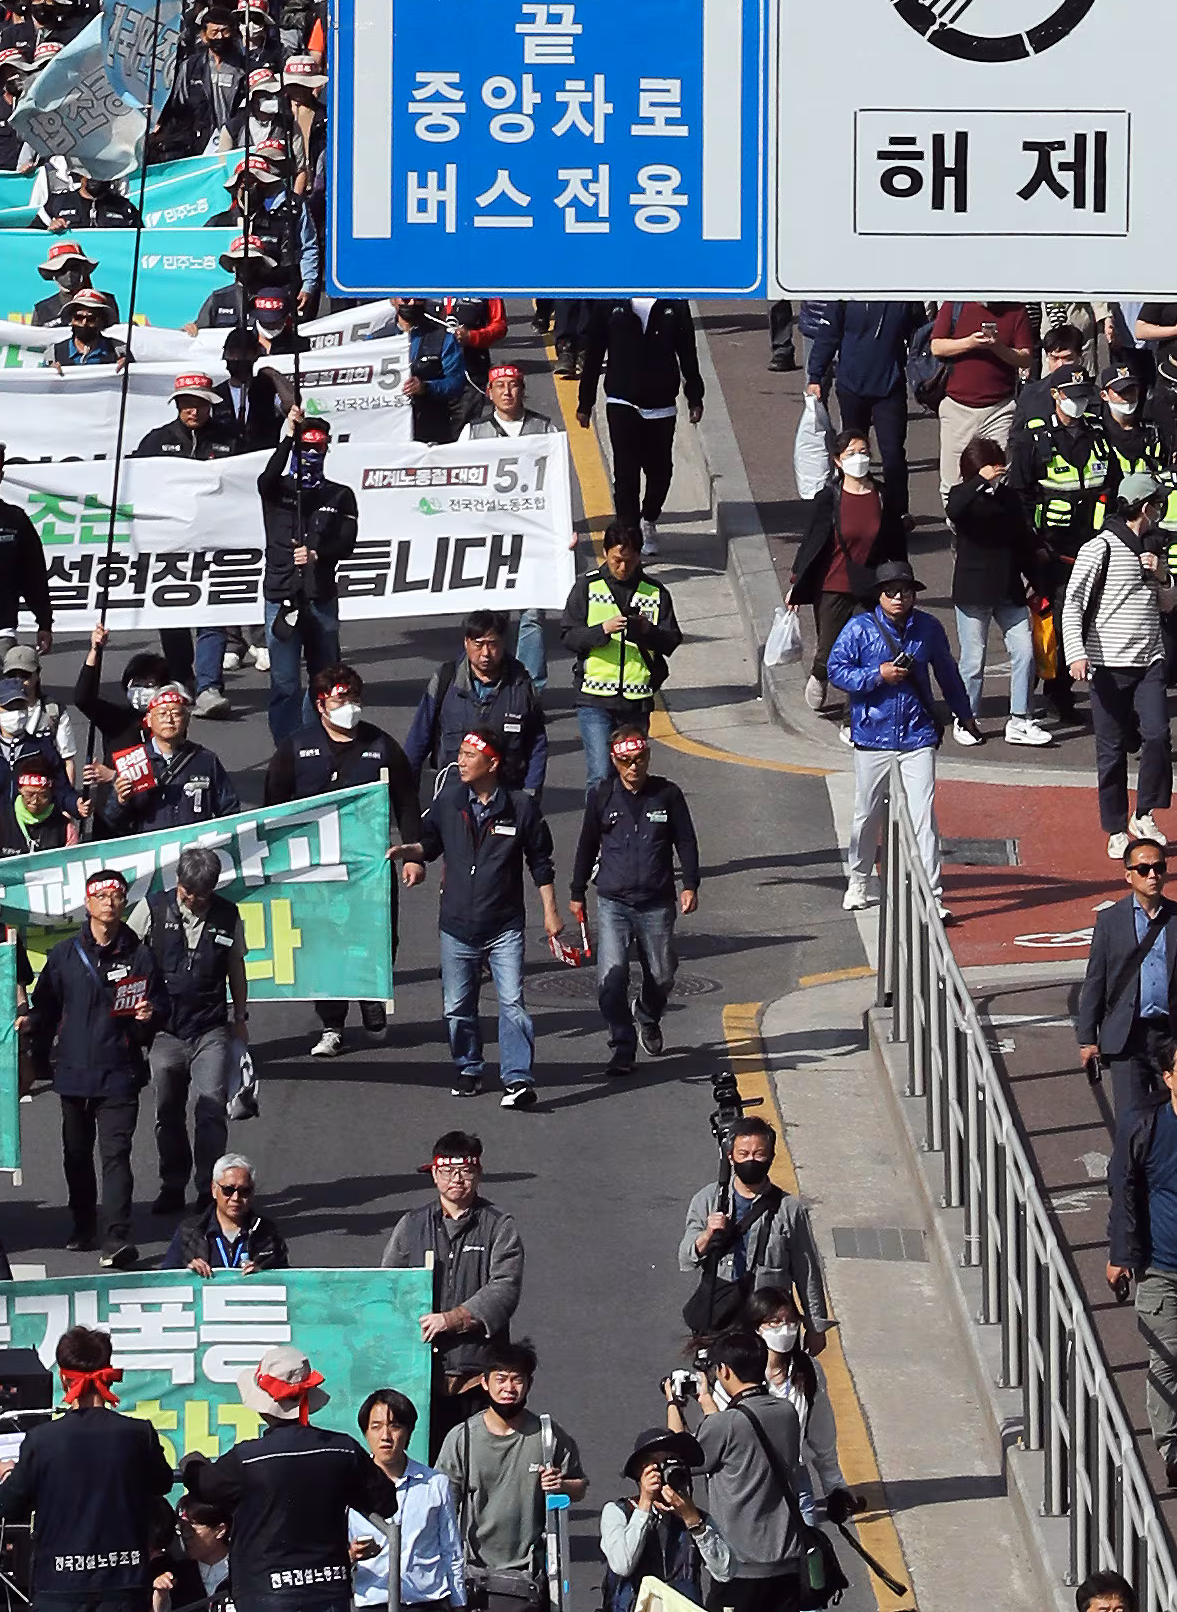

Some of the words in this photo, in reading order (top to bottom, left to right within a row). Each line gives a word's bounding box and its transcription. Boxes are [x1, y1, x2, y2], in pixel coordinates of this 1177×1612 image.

[514, 3, 584, 65] 끝
[407, 71, 690, 145] 중앙차로
[406, 162, 690, 235] 버스전용
[875, 129, 1108, 215] 해제
[163, 255, 216, 269] 민주노총
[448, 496, 547, 514] 전국건설노동조합
[494, 455, 549, 494] 5.1
[52, 547, 265, 611] 설현장을
[338, 533, 524, 599] 듭니다!
[55, 1550, 140, 1572] 전국건설노동조합
